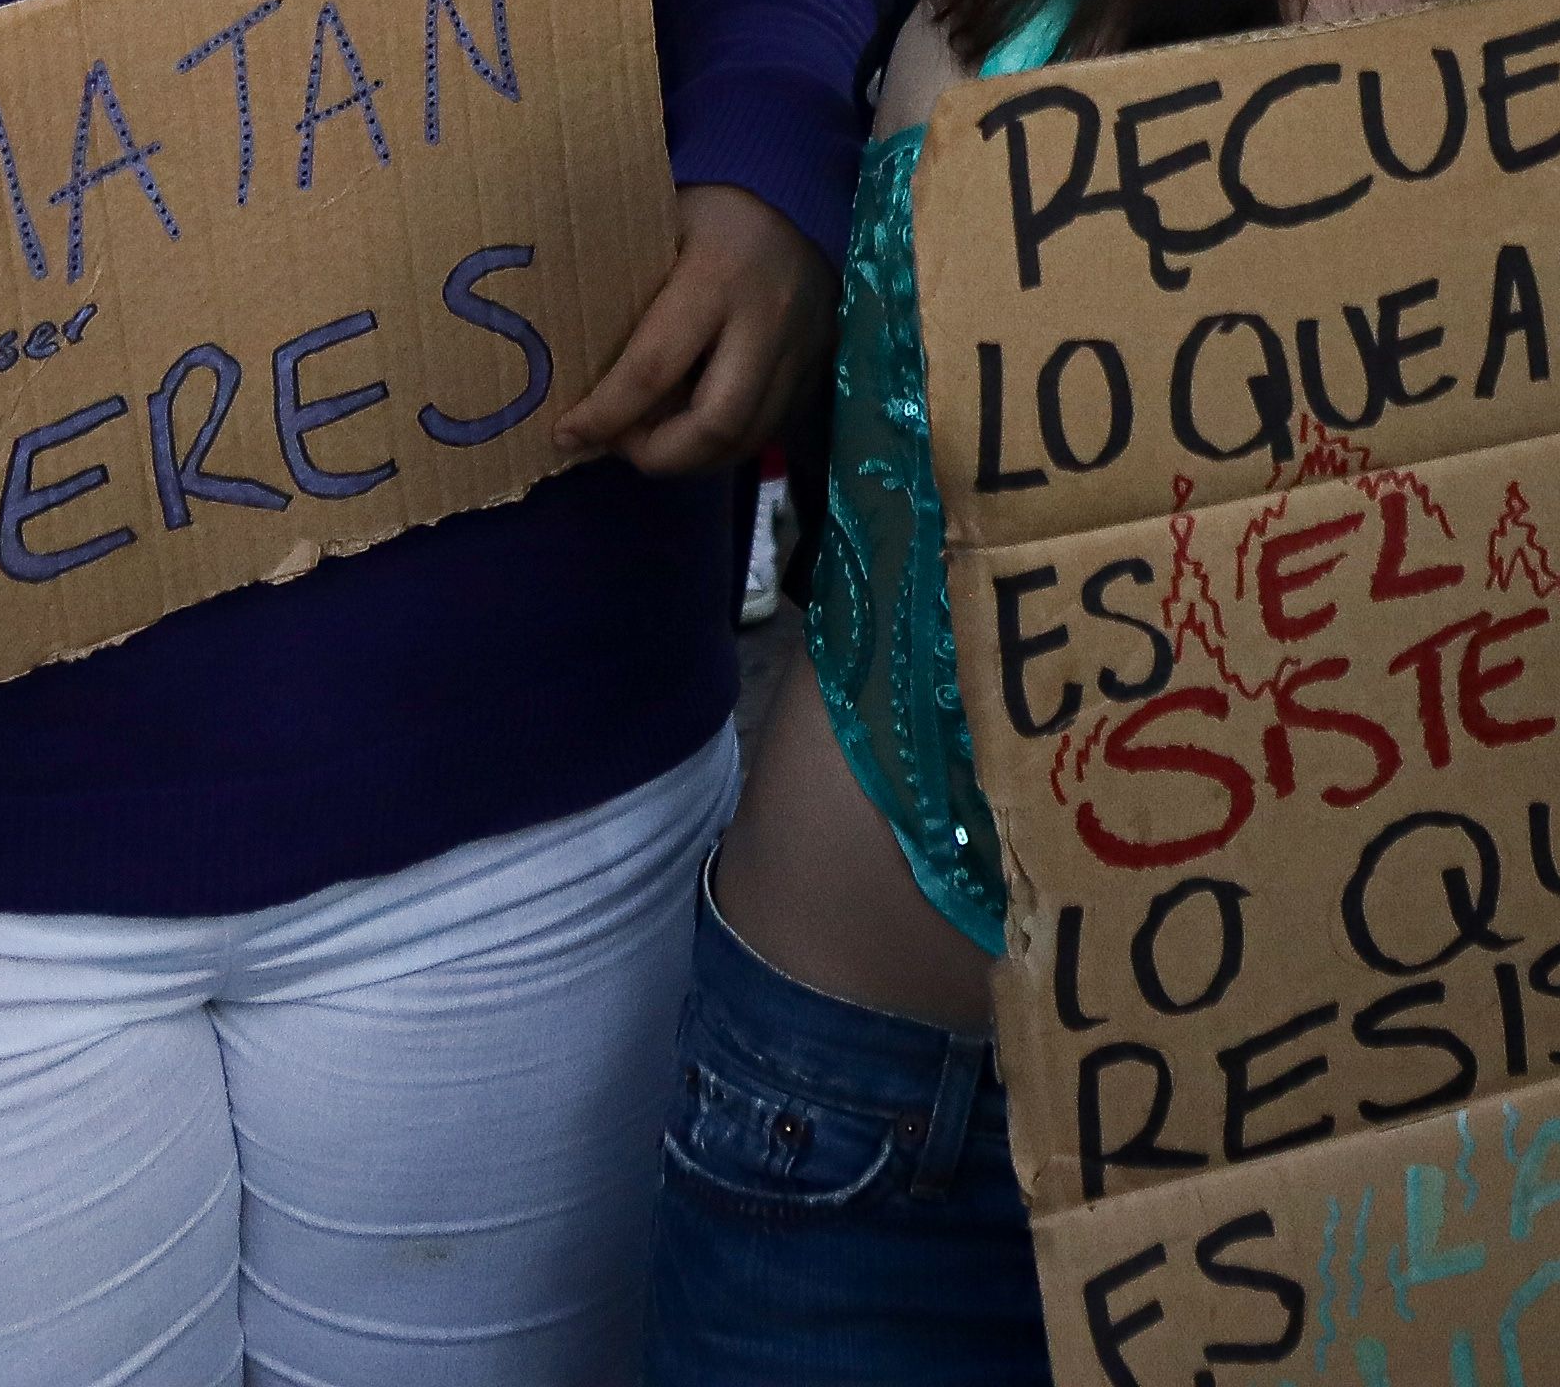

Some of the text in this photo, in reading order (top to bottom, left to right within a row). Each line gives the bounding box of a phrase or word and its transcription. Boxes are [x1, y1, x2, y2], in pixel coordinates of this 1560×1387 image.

[972, 337, 1134, 495] LO
[1169, 277, 1458, 467] QUE
[993, 495, 1465, 739] ES EL
[1082, 1210, 1308, 1387] ES
